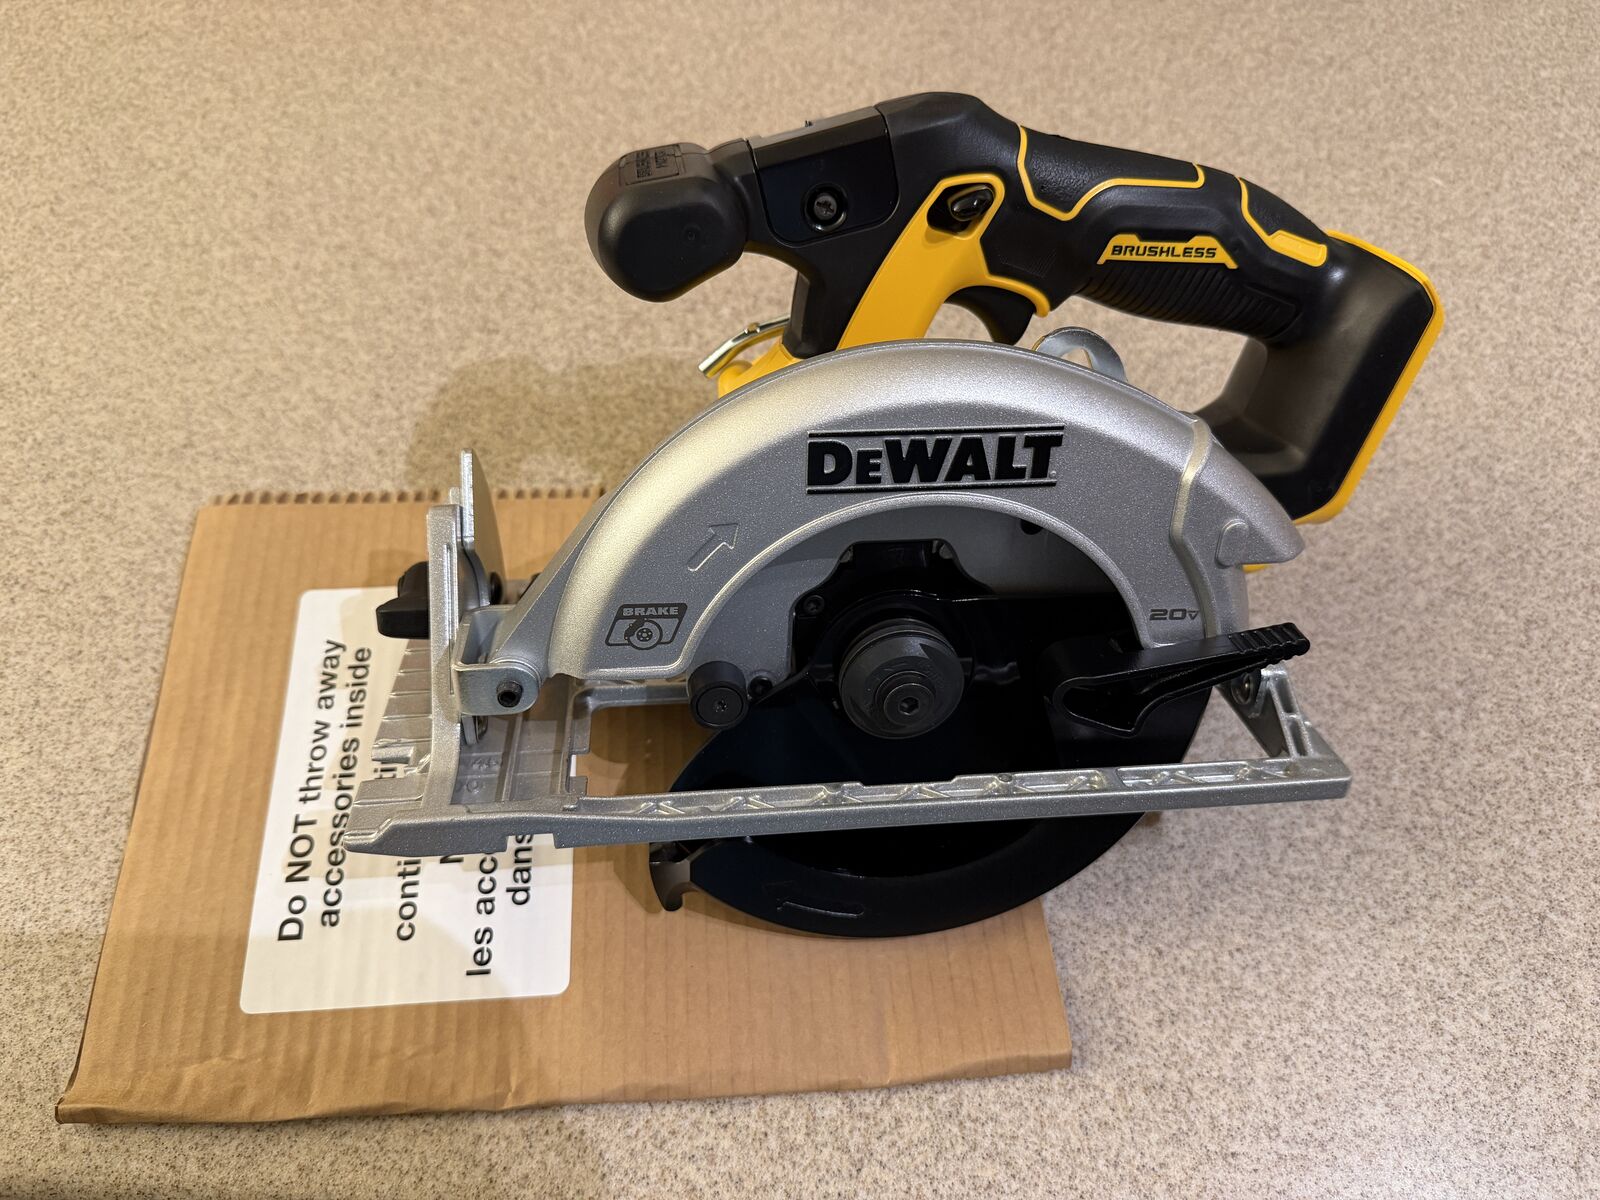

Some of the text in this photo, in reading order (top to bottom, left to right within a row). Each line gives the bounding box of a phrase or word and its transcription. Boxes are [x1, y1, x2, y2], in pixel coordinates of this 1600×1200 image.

[1111, 245, 1217, 258] BRUSHLESS
[622, 606, 679, 617] BRAKE
[277, 639, 348, 942] Do NOT throw away
[320, 646, 372, 928] accessories inside
[395, 857, 422, 942] conti
[465, 851, 499, 977] les acc
